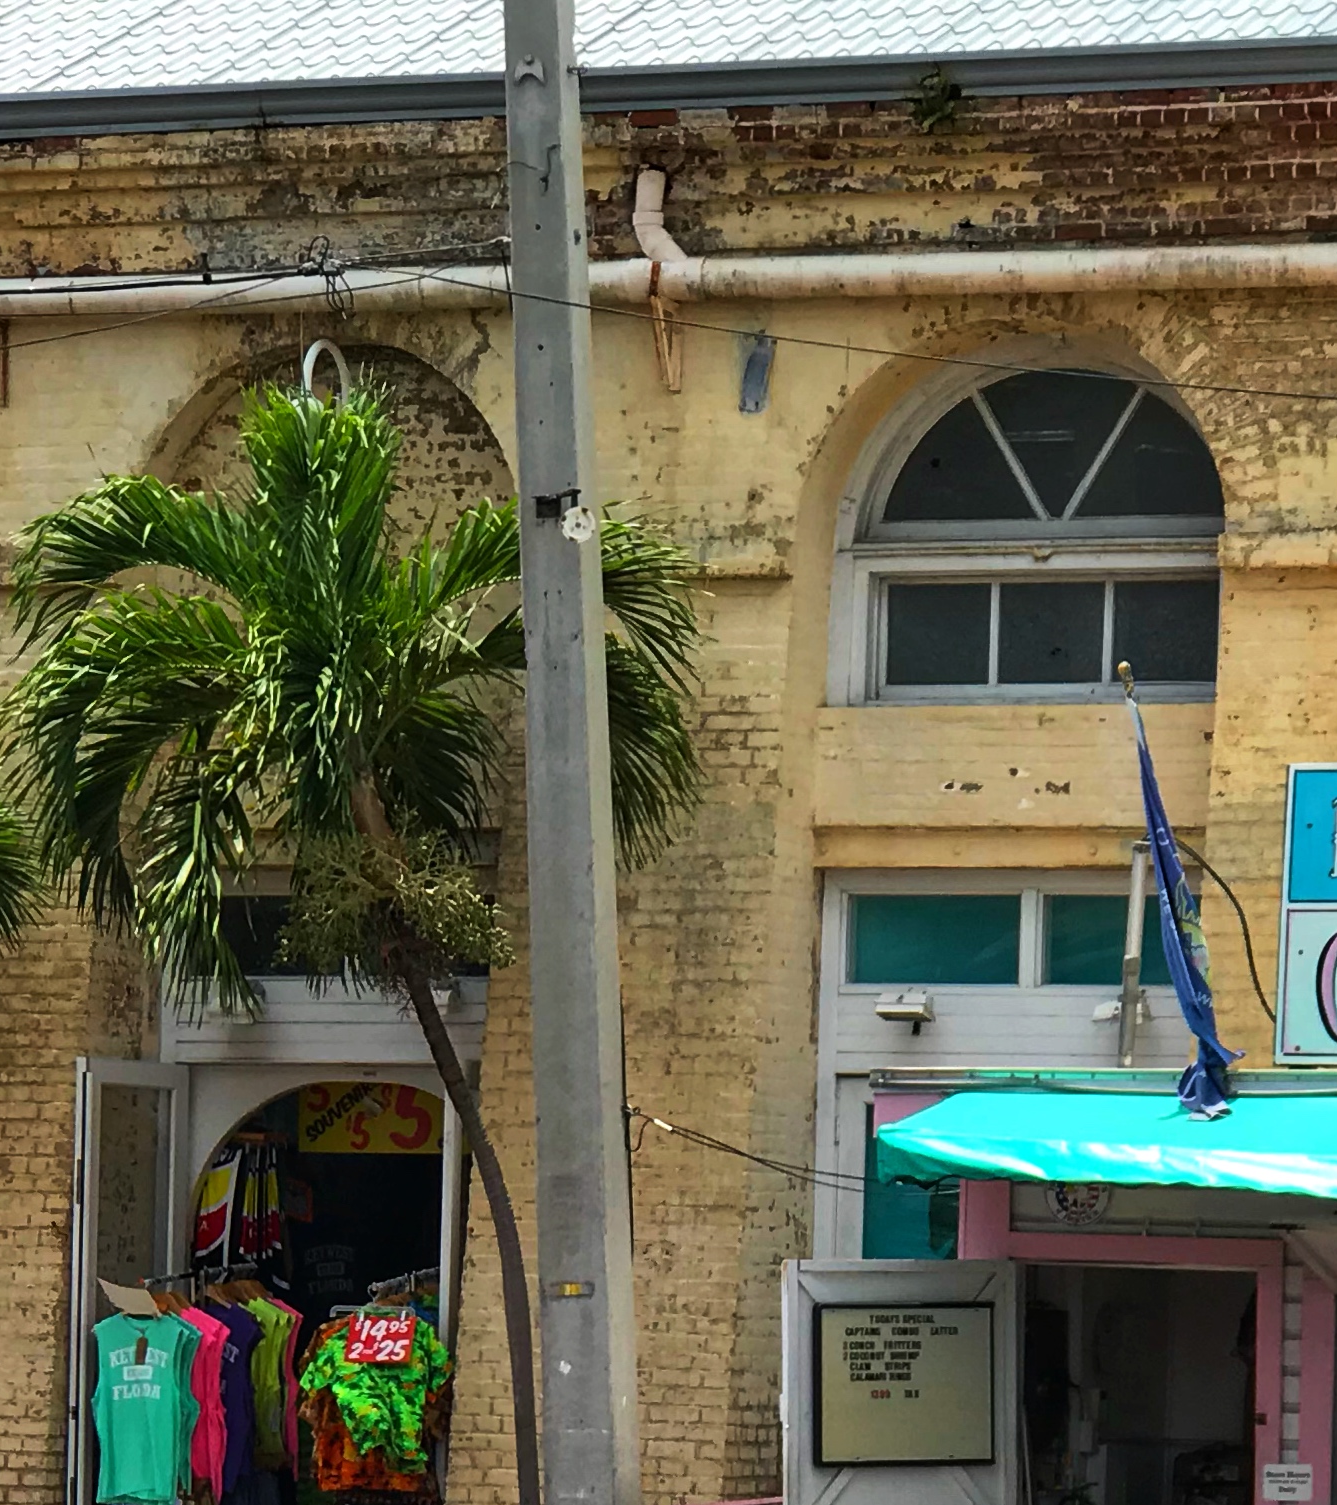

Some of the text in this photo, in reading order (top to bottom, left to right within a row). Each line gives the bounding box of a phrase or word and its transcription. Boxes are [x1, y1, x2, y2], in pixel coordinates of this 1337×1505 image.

[142, 1347, 168, 1368] EST
[349, 1342, 364, 1359] 2
[373, 1339, 410, 1361] $25
